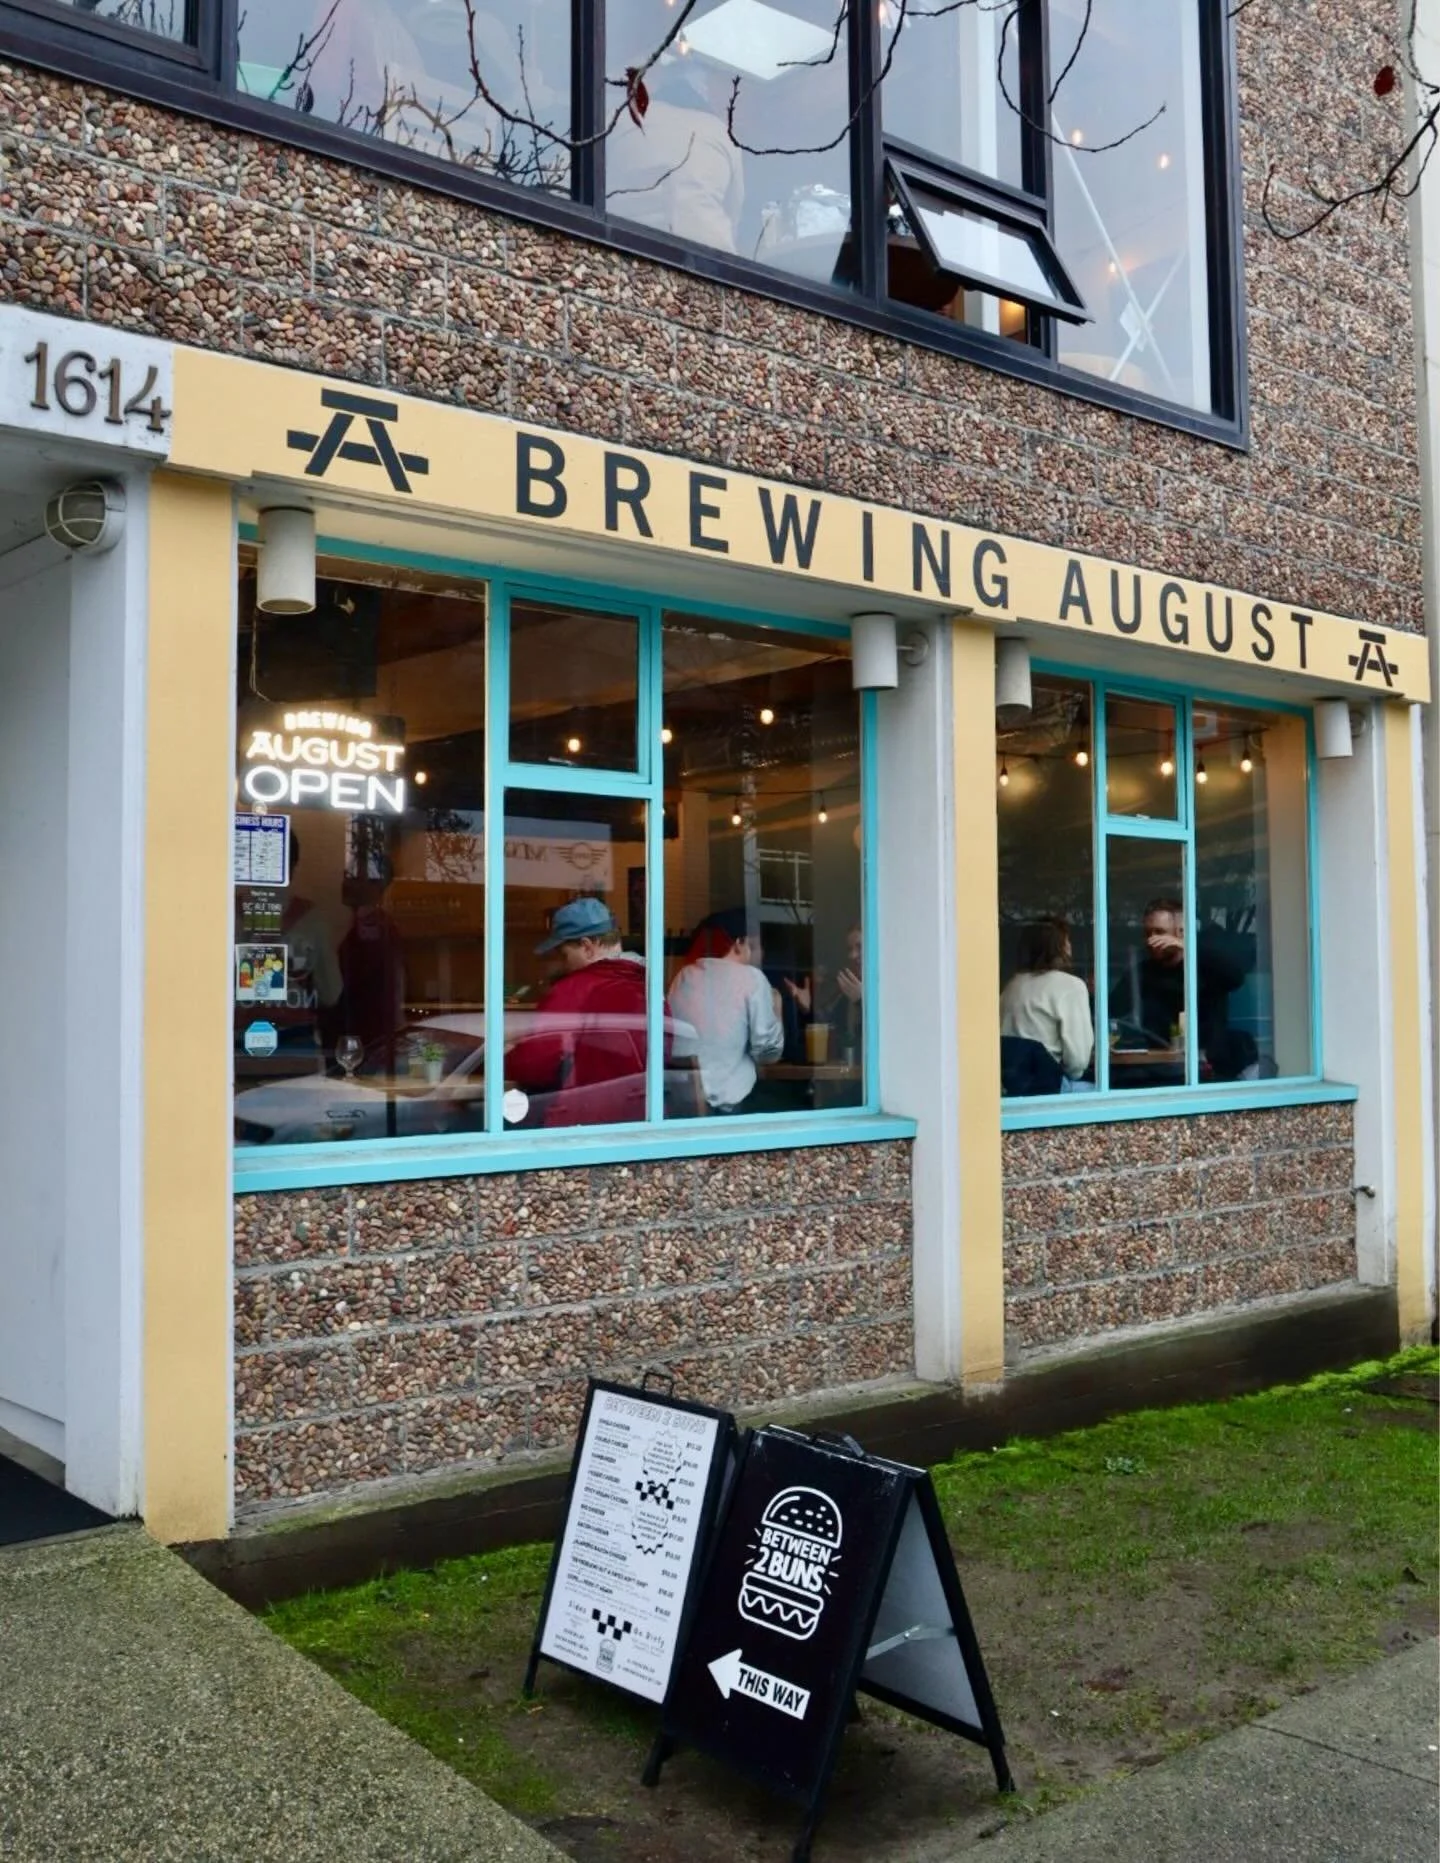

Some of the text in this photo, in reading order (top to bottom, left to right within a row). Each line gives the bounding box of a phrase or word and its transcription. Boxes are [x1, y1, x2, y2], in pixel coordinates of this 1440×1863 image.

[25, 341, 172, 433] 1614
[515, 431, 1008, 610] BREWING
[1058, 559, 1313, 669] AUGUST
[284, 711, 372, 738] BREWING
[246, 731, 404, 772] AUGUST
[245, 765, 405, 812] OPEN
[761, 1527, 832, 1566] BETWEEN
[738, 1668, 805, 1713] THIS WAY
